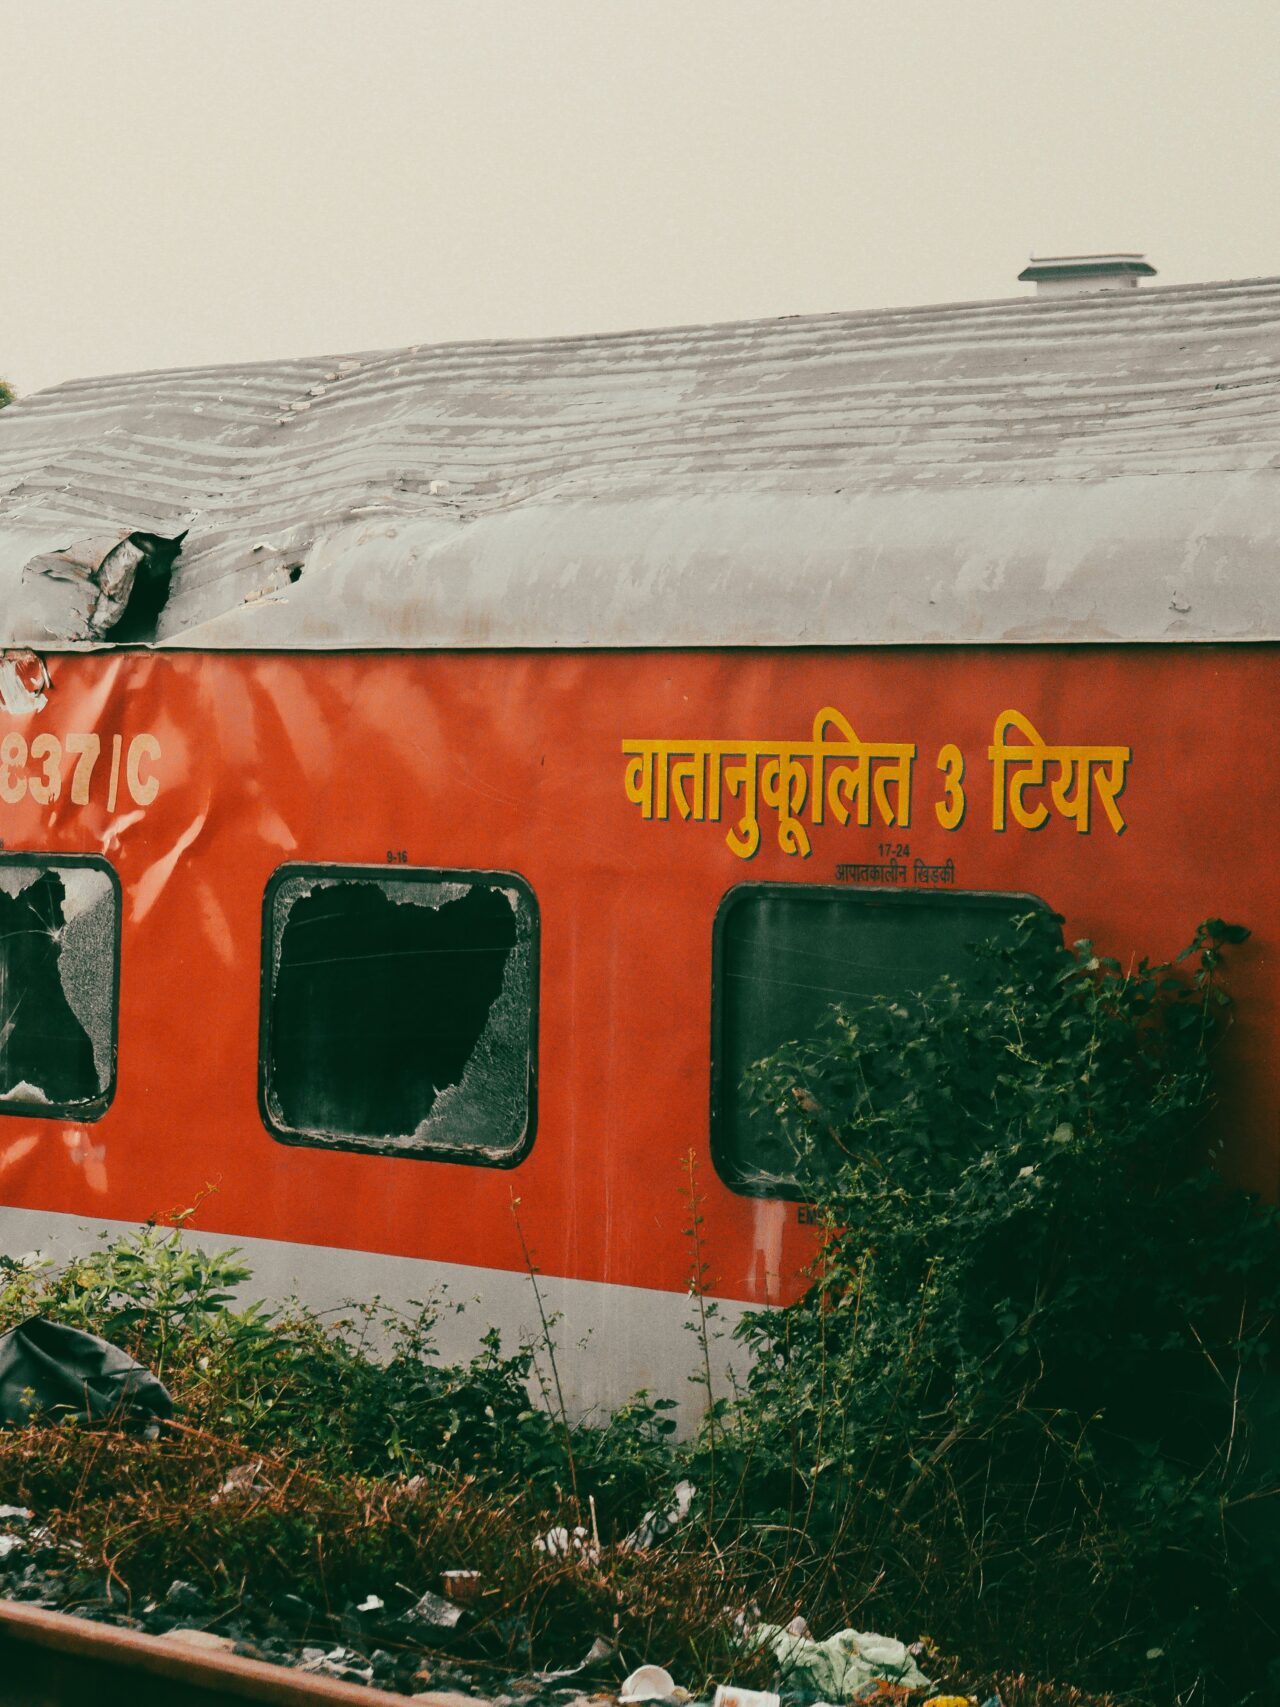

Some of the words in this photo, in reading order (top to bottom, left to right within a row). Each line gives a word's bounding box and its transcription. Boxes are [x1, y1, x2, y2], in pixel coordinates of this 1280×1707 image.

[622, 706, 917, 860] वातानुकूलित
[934, 743, 967, 831] 3
[988, 709, 1131, 836] टियर
[387, 850, 408, 864] 9-16
[878, 843, 911, 857] 17-24
[835, 859, 907, 883] आपातकालीन
